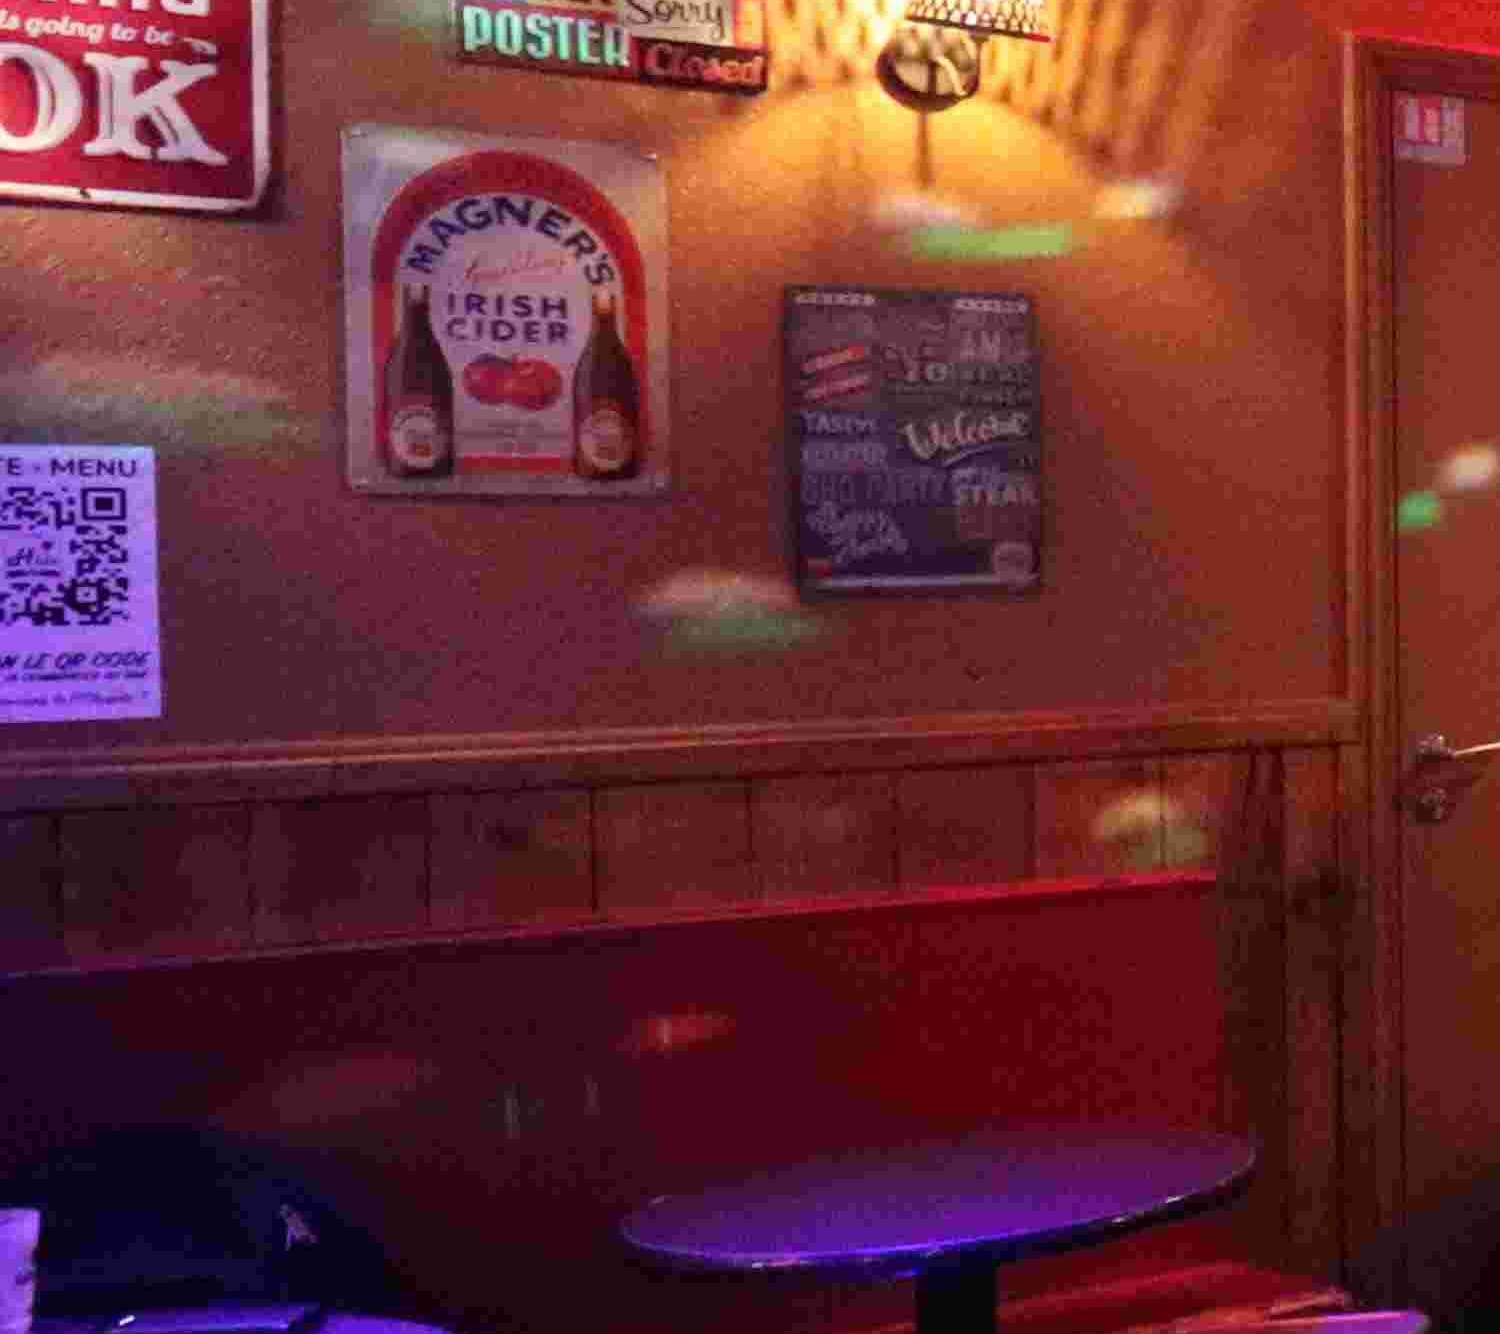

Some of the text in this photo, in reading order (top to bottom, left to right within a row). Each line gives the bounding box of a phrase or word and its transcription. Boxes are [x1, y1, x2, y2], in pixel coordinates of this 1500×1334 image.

[462, 5, 630, 67] POSTER
[0, 41, 229, 167] OK
[406, 196, 616, 287] MAGNER'S
[447, 293, 569, 319] IRISH
[446, 318, 570, 343] CIDER
[51, 458, 137, 477] MENU
